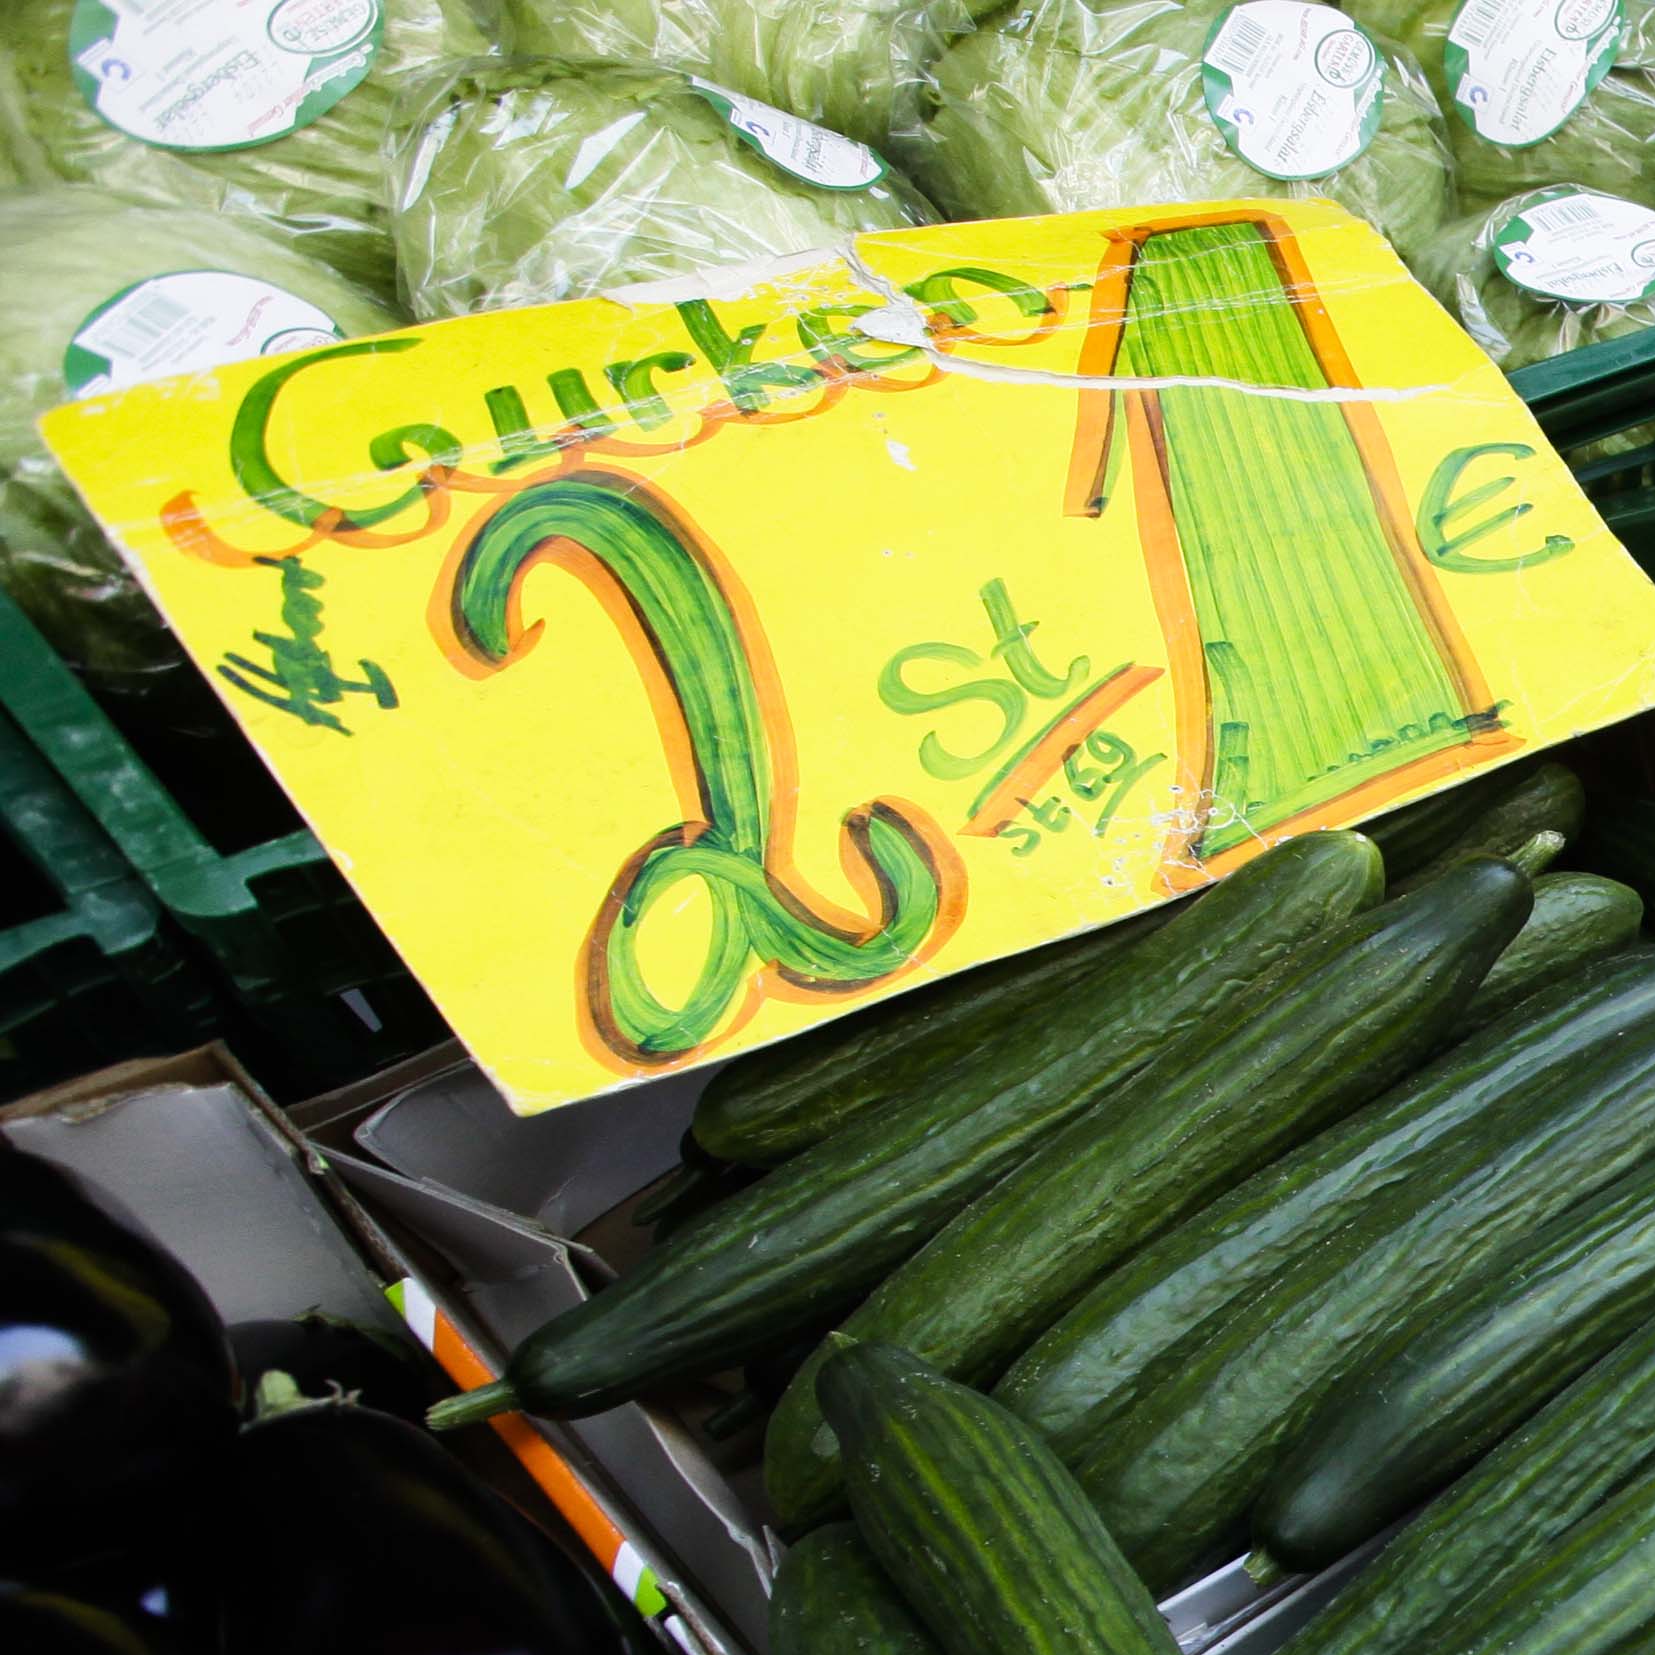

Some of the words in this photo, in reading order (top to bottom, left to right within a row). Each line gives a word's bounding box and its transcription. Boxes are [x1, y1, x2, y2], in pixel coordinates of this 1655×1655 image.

[1274, 88, 1329, 166] Eisbergsalat
[1511, 48, 1557, 131] Eisbergsalat
[427, 462, 968, 1069] 2
[878, 577, 1090, 781] St
[1064, 209, 1522, 895] 1
[1417, 443, 1576, 574] €
